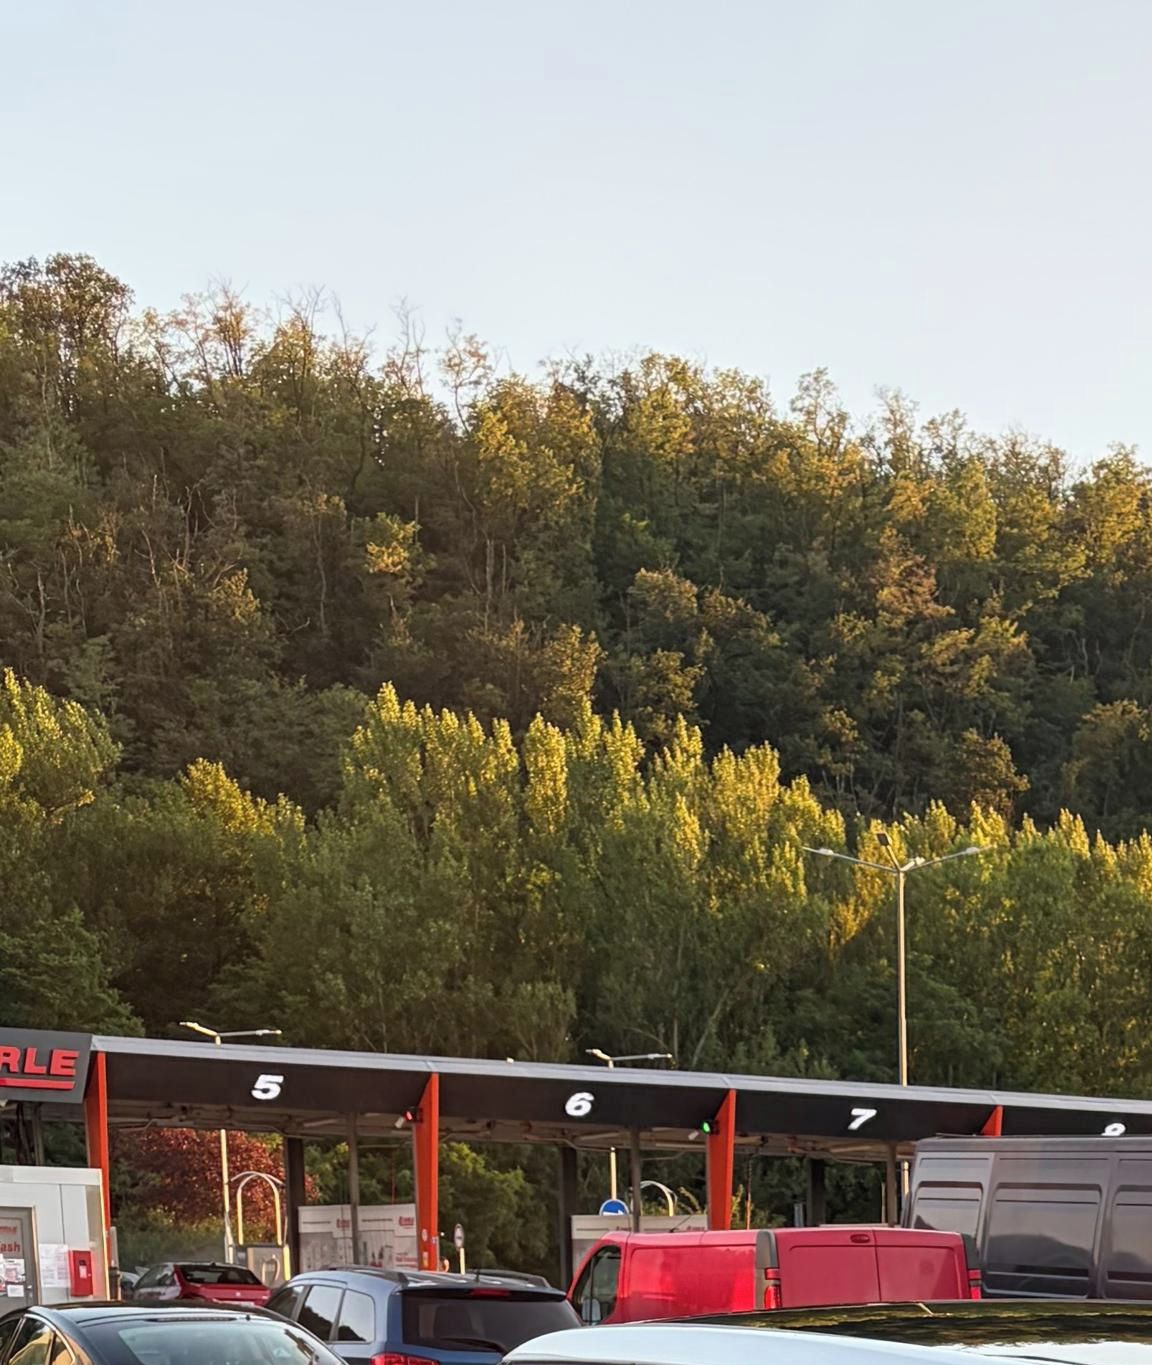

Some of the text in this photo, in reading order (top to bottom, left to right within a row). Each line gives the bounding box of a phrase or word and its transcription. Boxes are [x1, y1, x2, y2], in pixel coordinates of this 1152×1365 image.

[251, 1074, 284, 1100] 5
[565, 1092, 594, 1117] 6
[847, 1108, 878, 1131] 7
